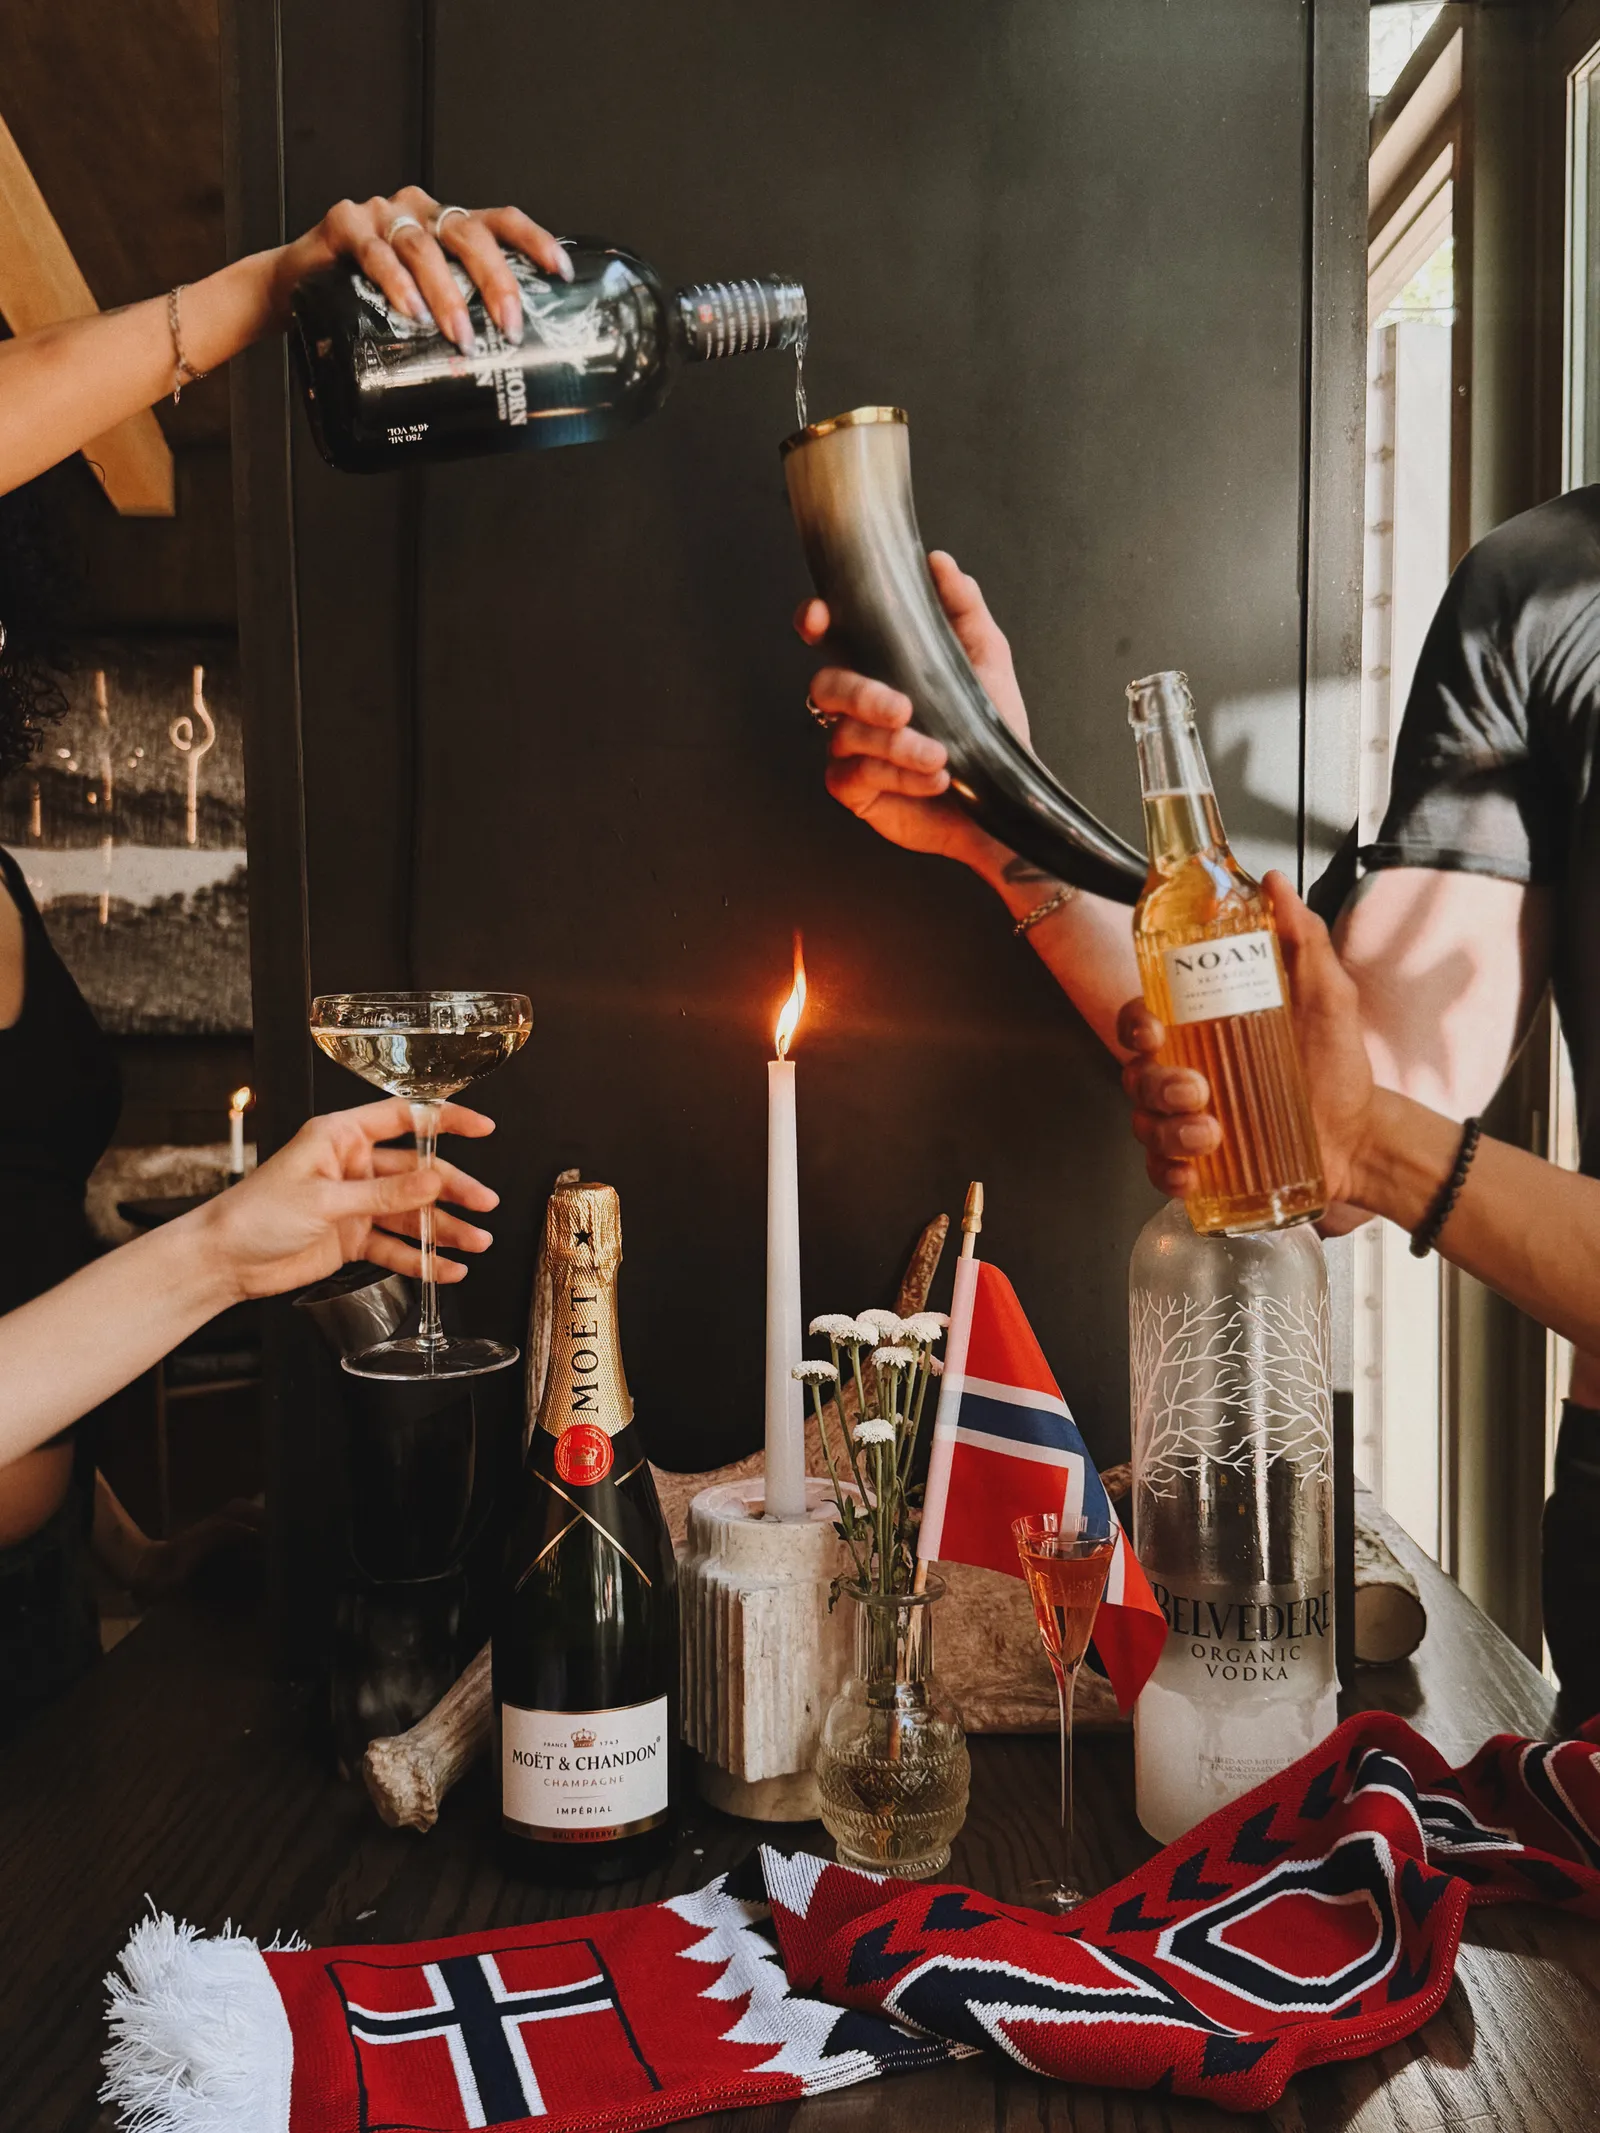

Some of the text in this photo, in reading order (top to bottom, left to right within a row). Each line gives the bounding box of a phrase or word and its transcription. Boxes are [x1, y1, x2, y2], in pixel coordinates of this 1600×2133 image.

[387, 422, 429, 437] 46% VOL
[388, 432, 423, 444] 750 ML
[1174, 942, 1268, 976] NOAM
[566, 1288, 599, 1413] MOËT
[1151, 1581, 1331, 1642] BELVEDERE
[1191, 1643, 1301, 1664] ORGANIC
[1206, 1664, 1288, 1682] VODKA
[512, 1743, 657, 1771] MOËT & CHANDON
[543, 1774, 625, 1788] CHAMPAGNE
[556, 1806, 613, 1815] IMPÉRIAL
